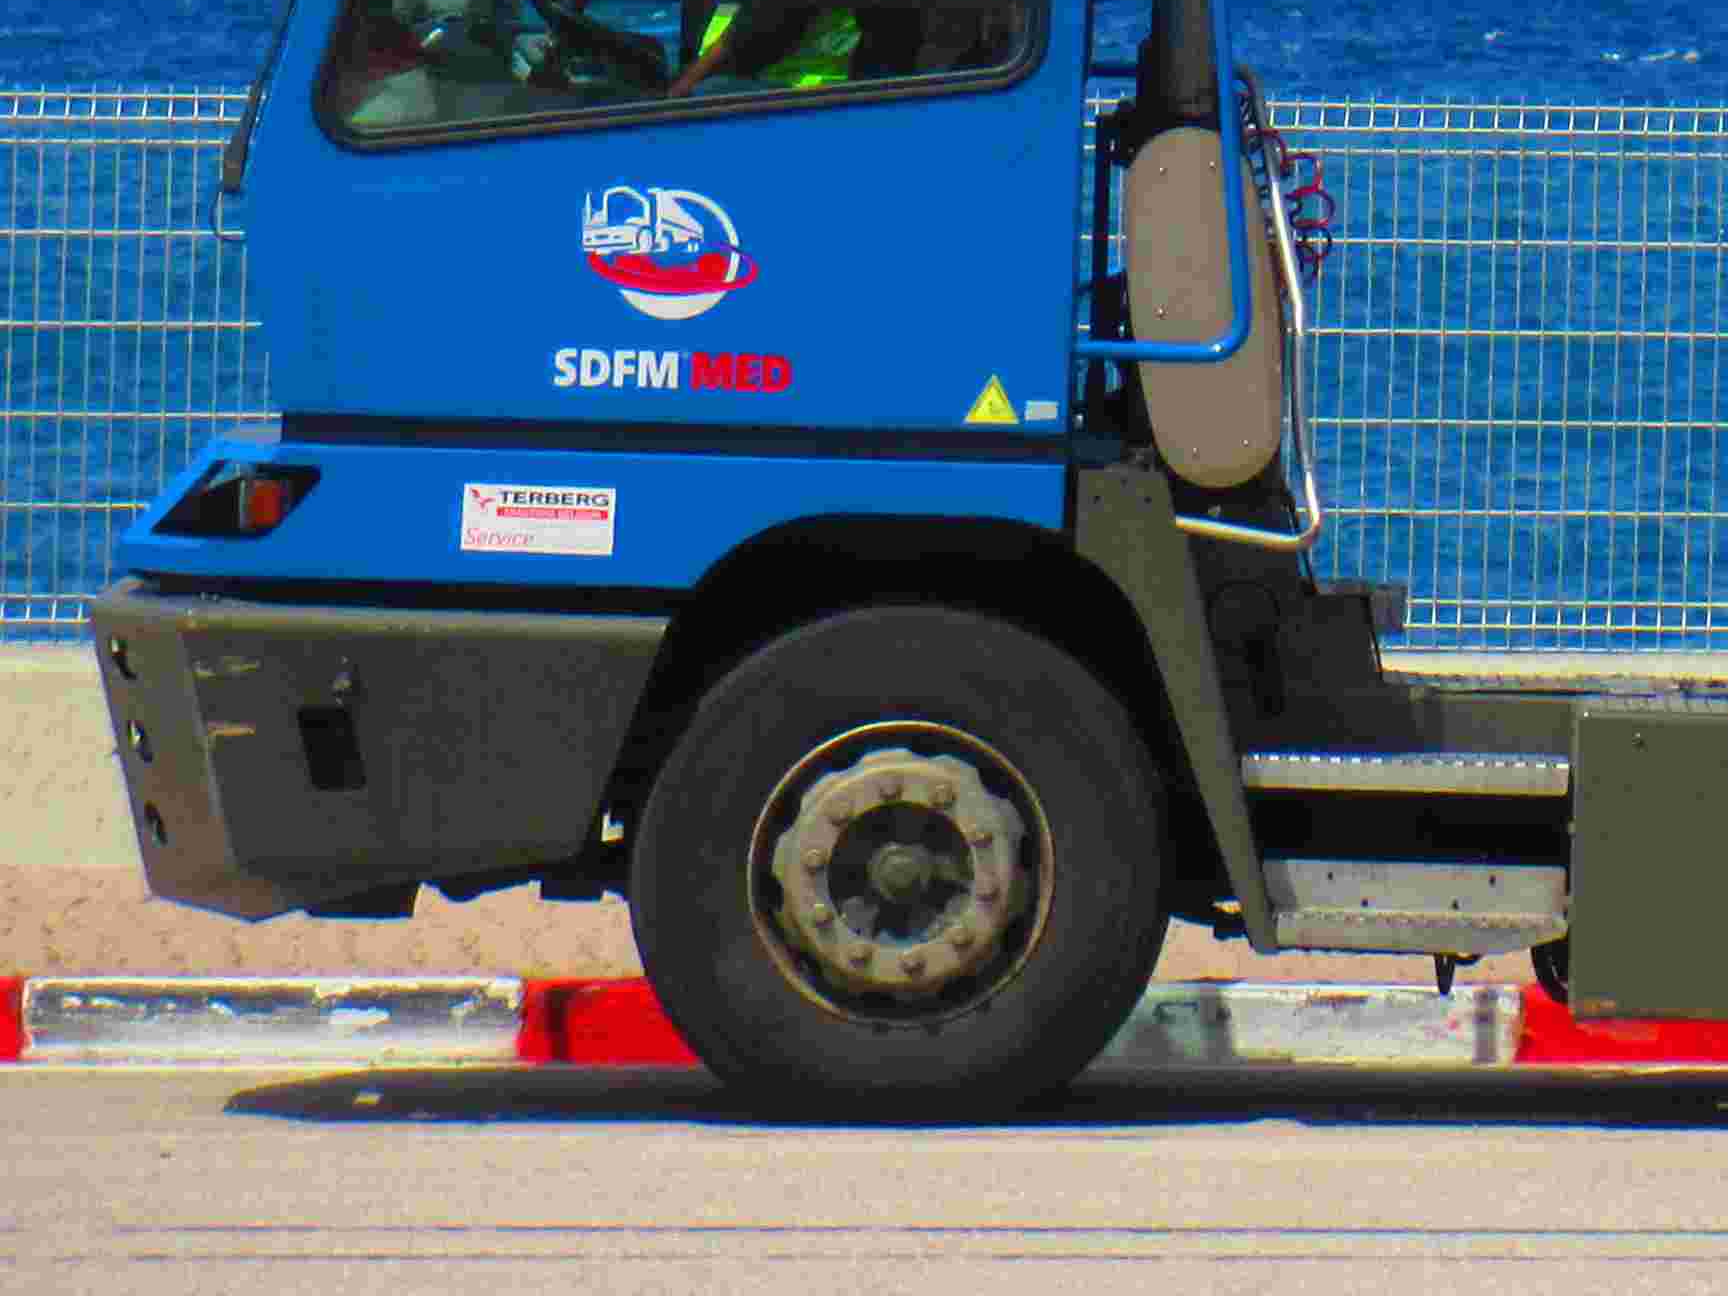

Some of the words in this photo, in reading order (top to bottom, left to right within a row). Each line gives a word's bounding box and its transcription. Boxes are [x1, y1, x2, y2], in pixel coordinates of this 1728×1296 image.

[553, 348, 680, 389] SDFM
[690, 352, 792, 393] MED
[498, 489, 610, 506] TERBERG
